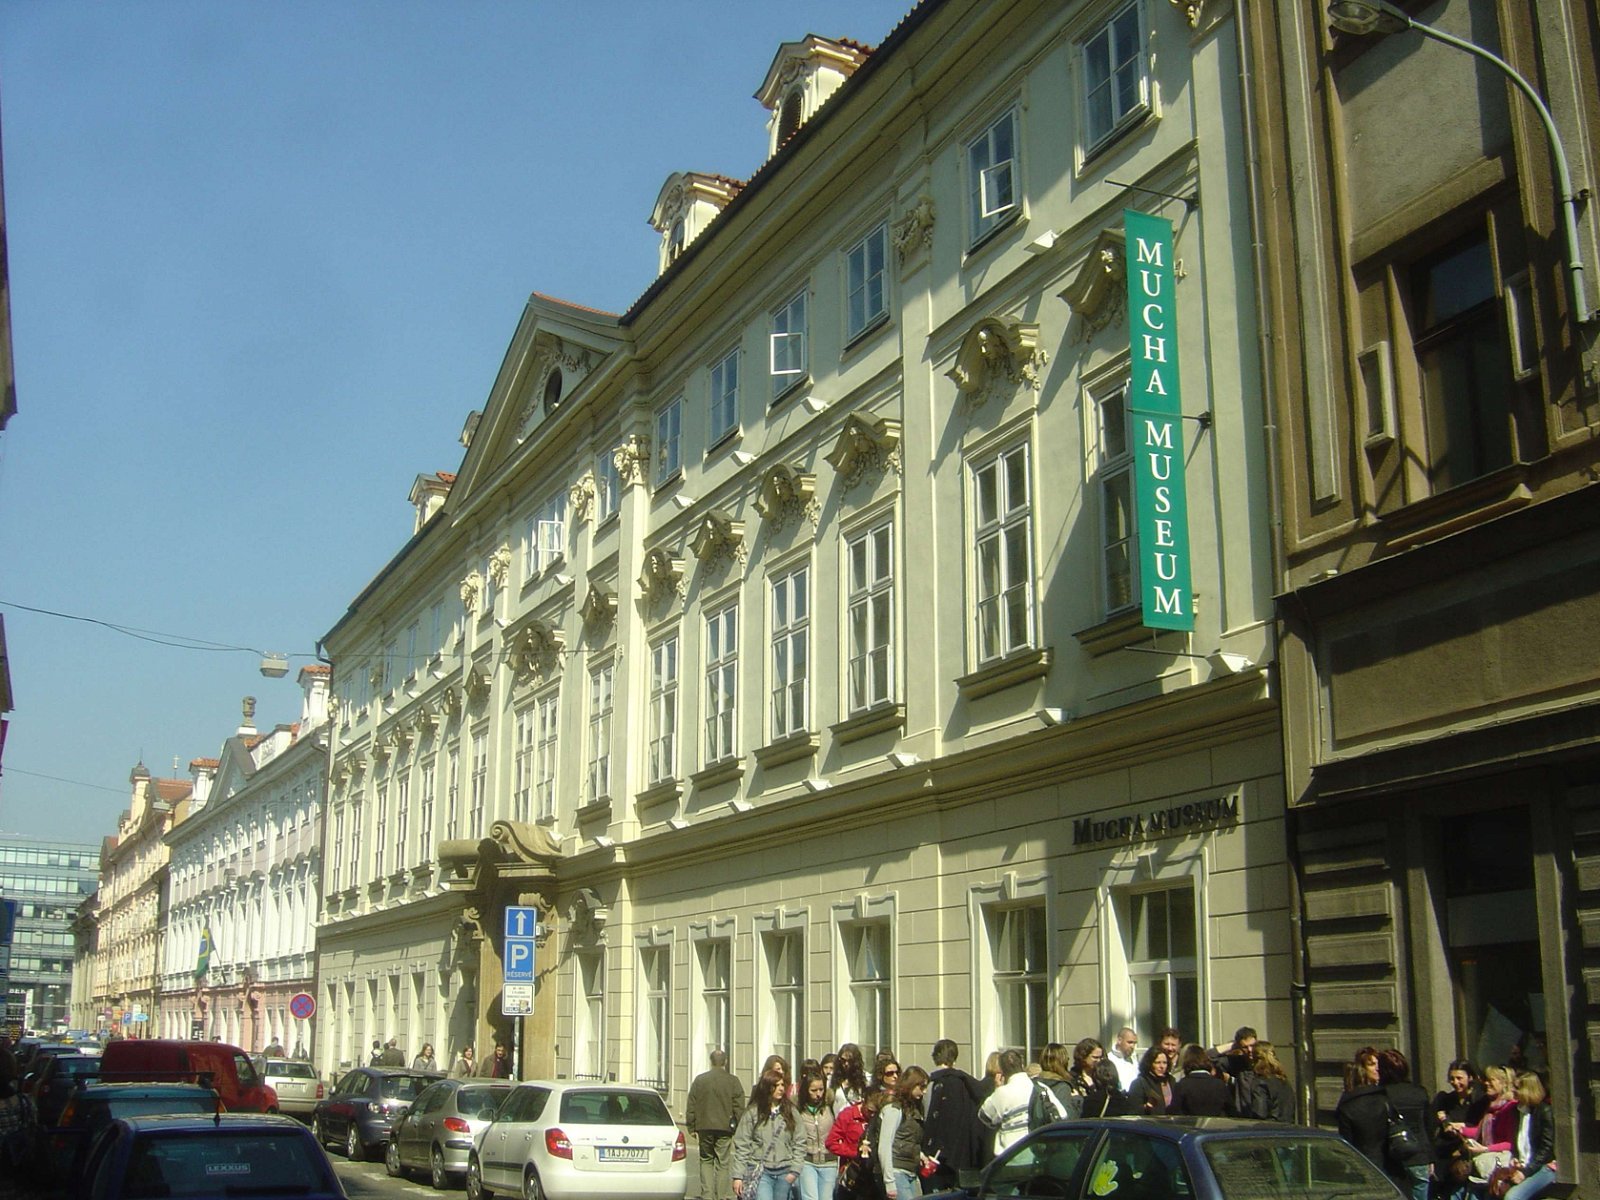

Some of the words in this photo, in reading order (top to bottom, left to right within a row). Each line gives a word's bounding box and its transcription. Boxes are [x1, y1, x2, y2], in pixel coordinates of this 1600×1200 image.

[1136, 237, 1168, 396] MUCHA
[1144, 419, 1184, 615] MUSEUM
[1072, 813, 1144, 845] MUCHA
[1150, 795, 1239, 832] MUSEUM
[511, 944, 528, 968] P
